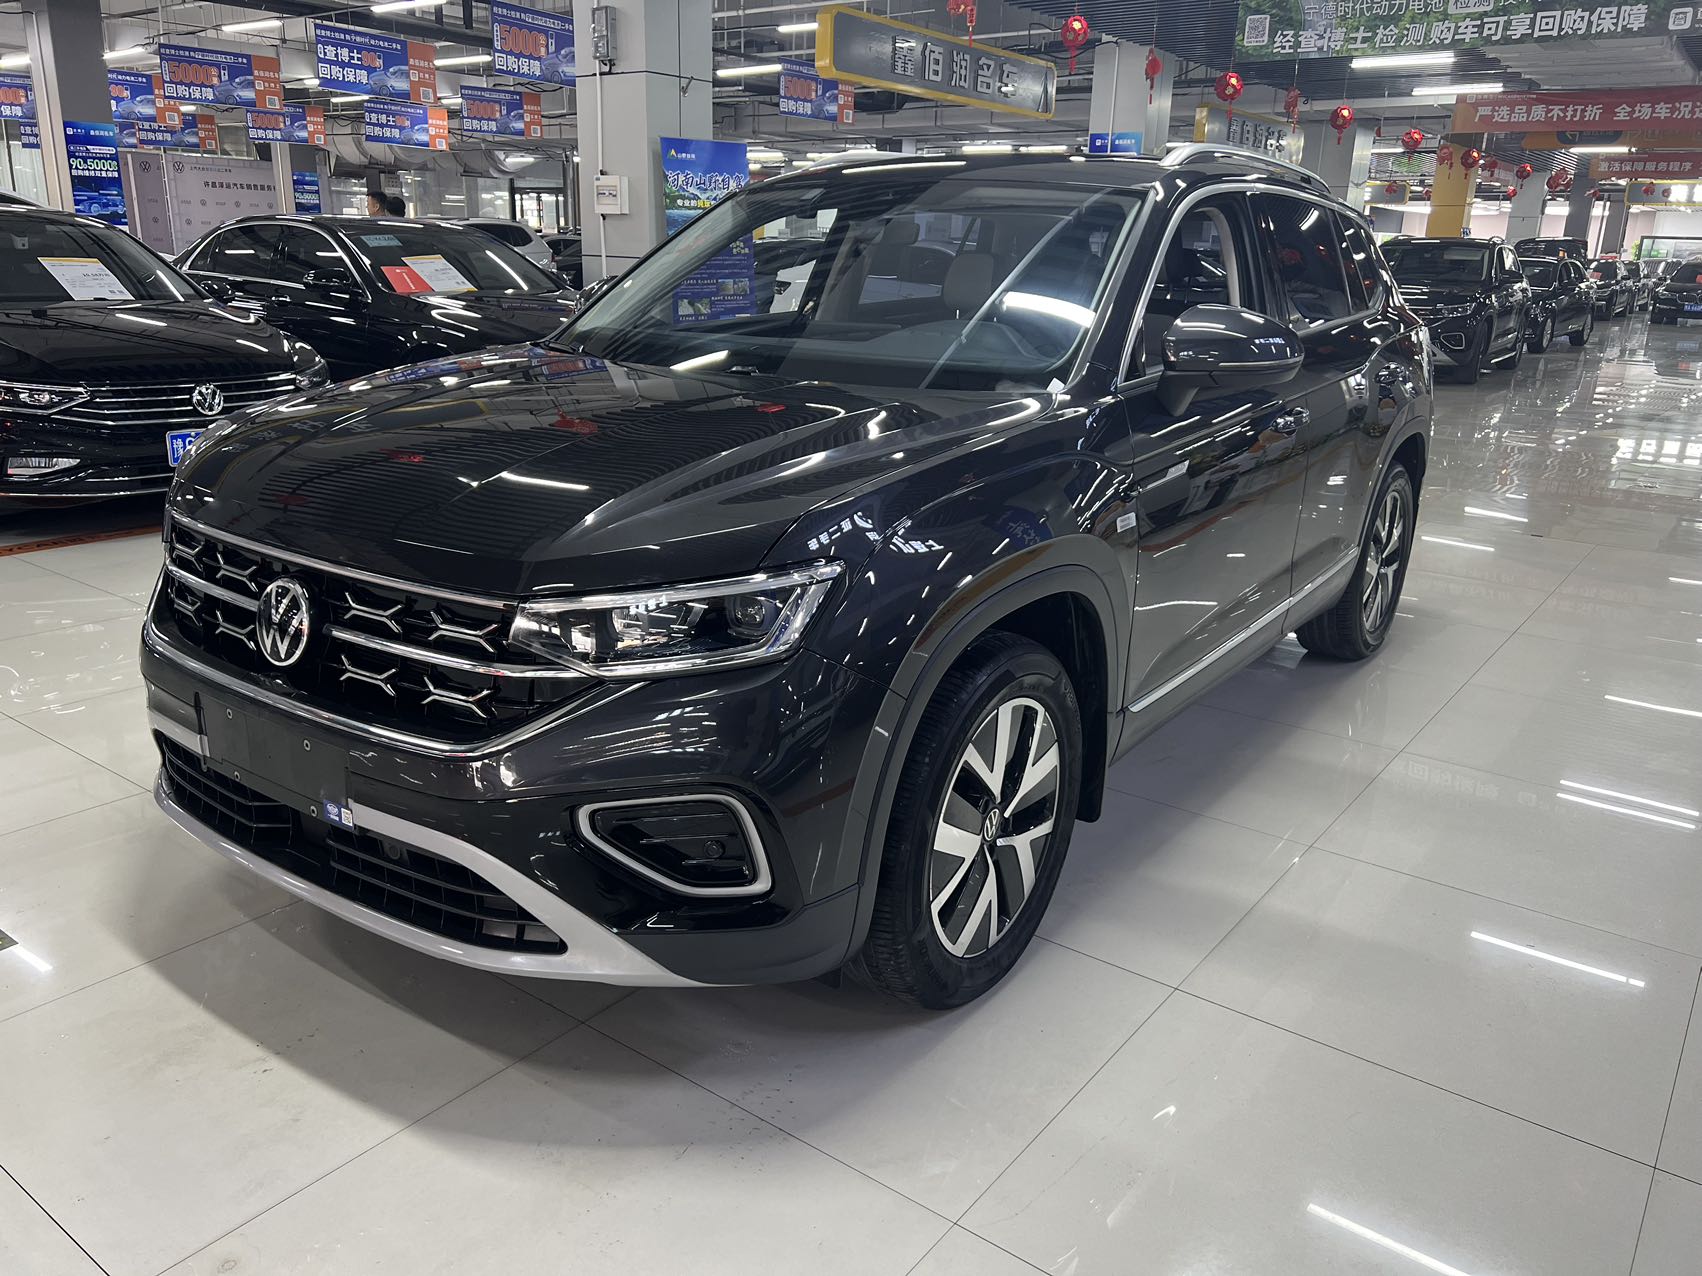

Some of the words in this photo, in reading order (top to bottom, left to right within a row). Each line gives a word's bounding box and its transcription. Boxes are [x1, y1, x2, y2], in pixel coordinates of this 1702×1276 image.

[1272, 4, 1648, 54] 经查博士检测购车可享回购保障
[168, 61, 220, 86] 5000公里
[318, 63, 368, 85] 回购保障
[495, 53, 541, 77] 回购保障
[892, 35, 1019, 98] 鑫佰润名车
[164, 83, 215, 100] 回购保障
[779, 98, 812, 115] 回购保障
[1475, 104, 1603, 123] 严选品质不打折
[249, 128, 282, 139] 回购保障
[365, 125, 401, 138] 回购保障
[463, 119, 497, 131] 回购保障
[139, 131, 172, 142] 回购保障
[667, 170, 744, 192] 河南山野自驾
